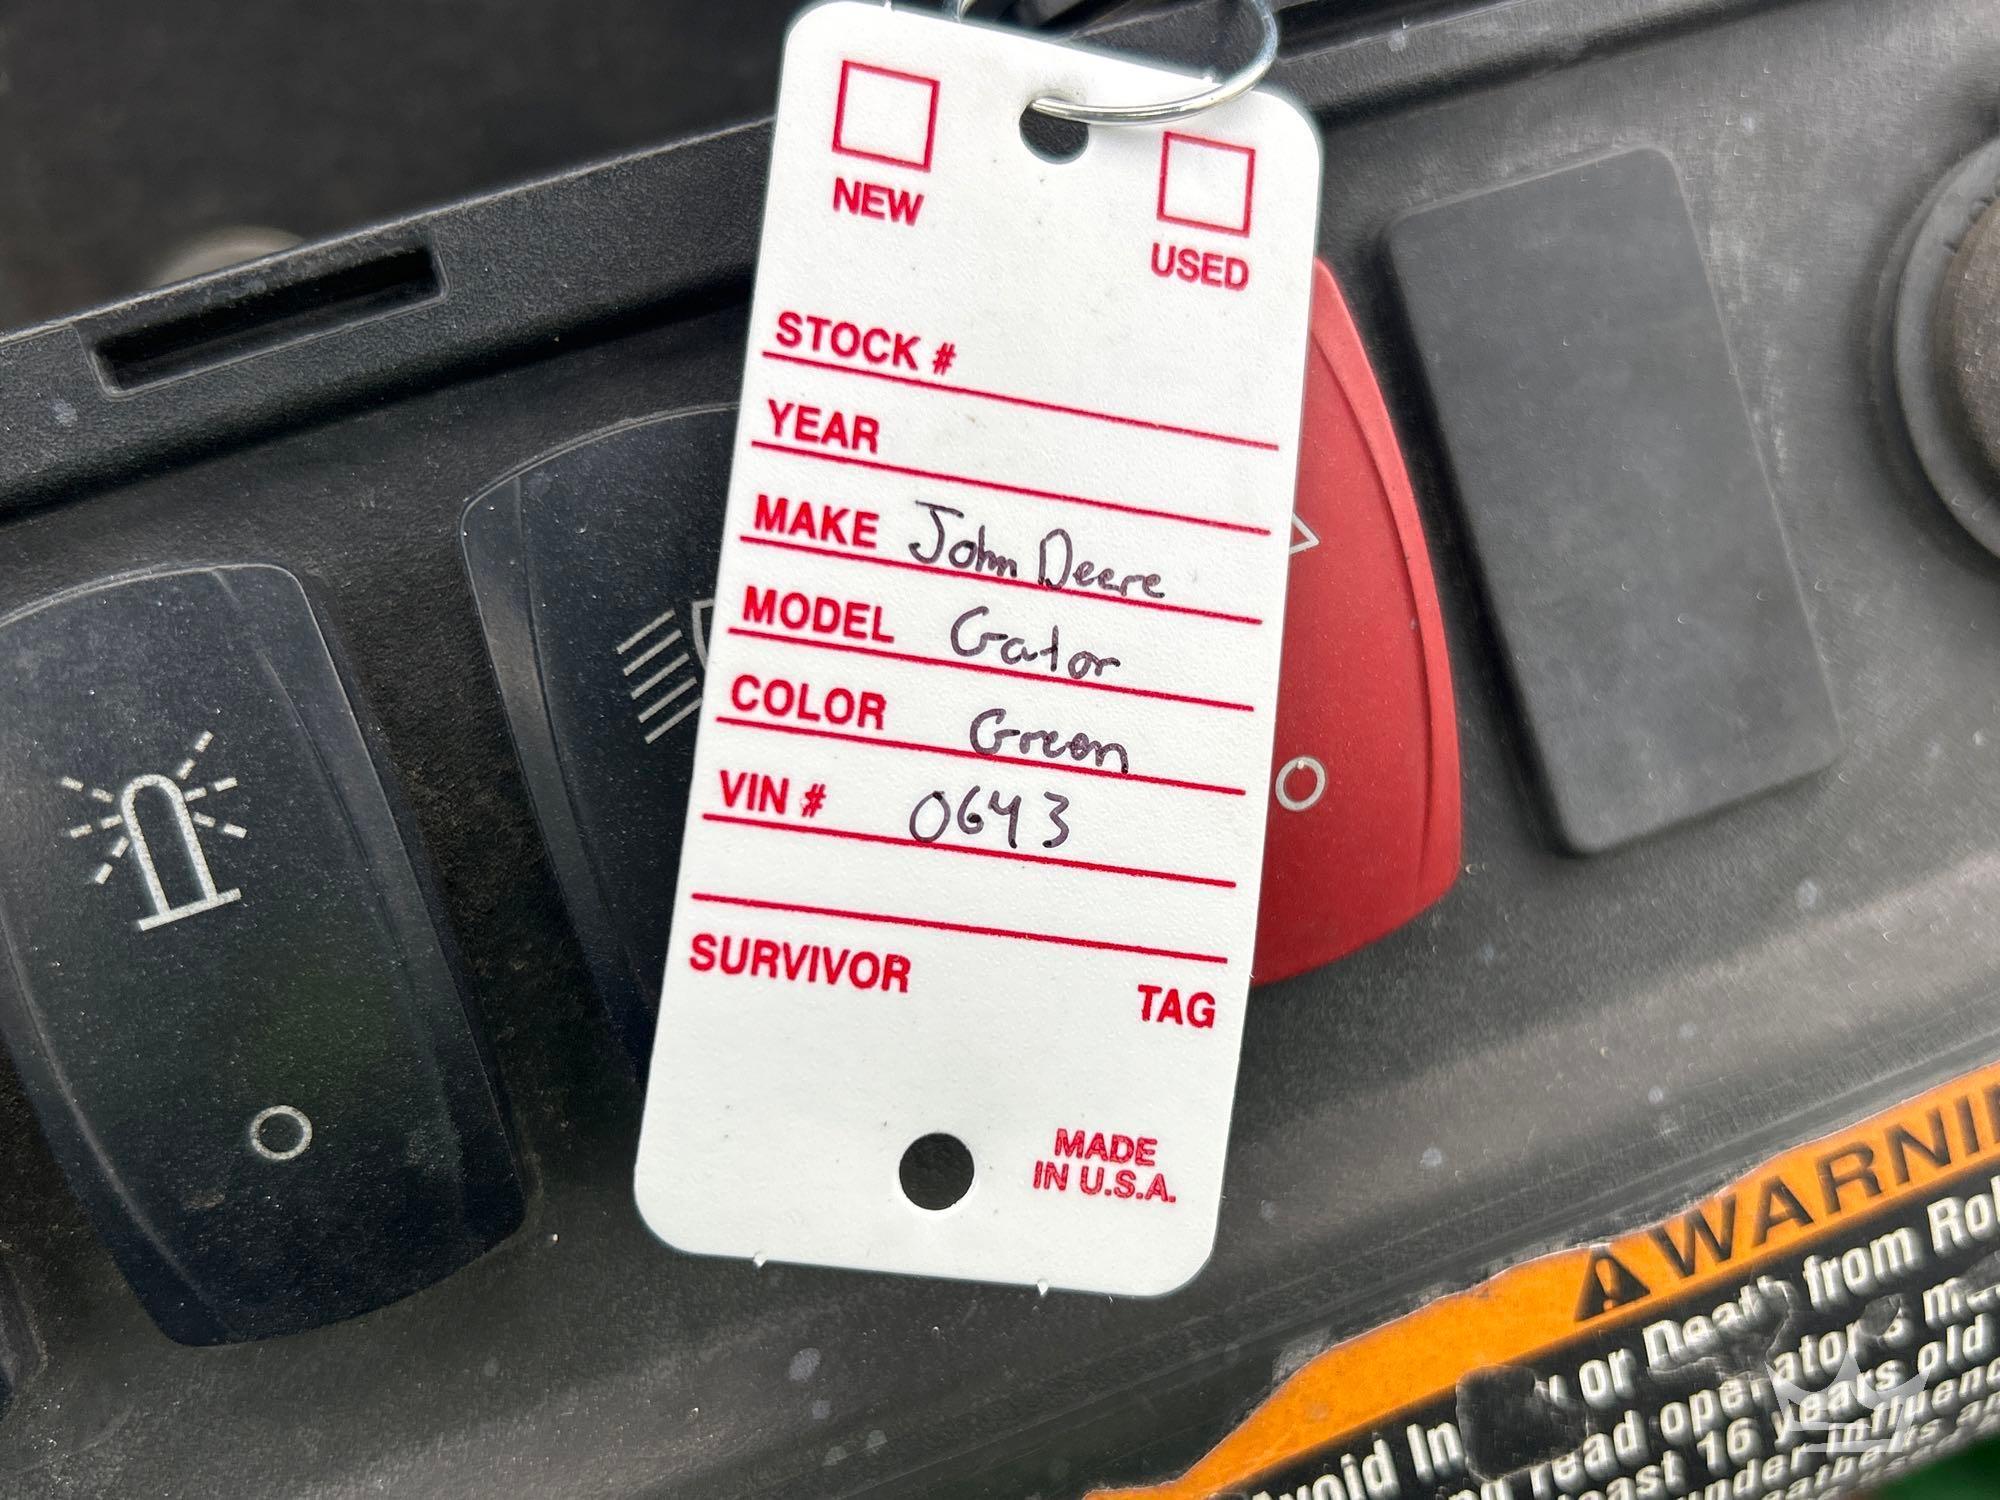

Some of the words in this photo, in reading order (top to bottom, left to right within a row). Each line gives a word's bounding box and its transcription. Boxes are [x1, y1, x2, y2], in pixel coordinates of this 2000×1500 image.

[832, 176, 924, 225] NEW
[1151, 243, 1249, 291] USED
[775, 310, 920, 371] STOCK
[932, 342, 956, 375] #
[768, 398, 880, 455] YEAR
[753, 493, 879, 550] MAKE
[908, 499, 1018, 578] John
[1037, 528, 1166, 599] Deere
[741, 584, 894, 644] MODEL
[950, 605, 1121, 680] Gator
[730, 673, 887, 731] COLOR
[969, 708, 1129, 775] Green
[719, 769, 790, 815] VIN
[801, 783, 826, 817] #
[909, 785, 1070, 850] 0643
[689, 932, 912, 993] SURVIVOR
[1137, 984, 1216, 1029] TAG
[1054, 1128, 1158, 1167] MADE
[1032, 1160, 1069, 1192] IN
[1079, 1165, 1176, 1204] U.S.A.
[1578, 1348, 1637, 1408] or
[1803, 1226, 1926, 1312] from
[1697, 1417, 1761, 1478] 16
[1770, 1358, 1907, 1453] years
[1917, 1312, 1994, 1386] old
